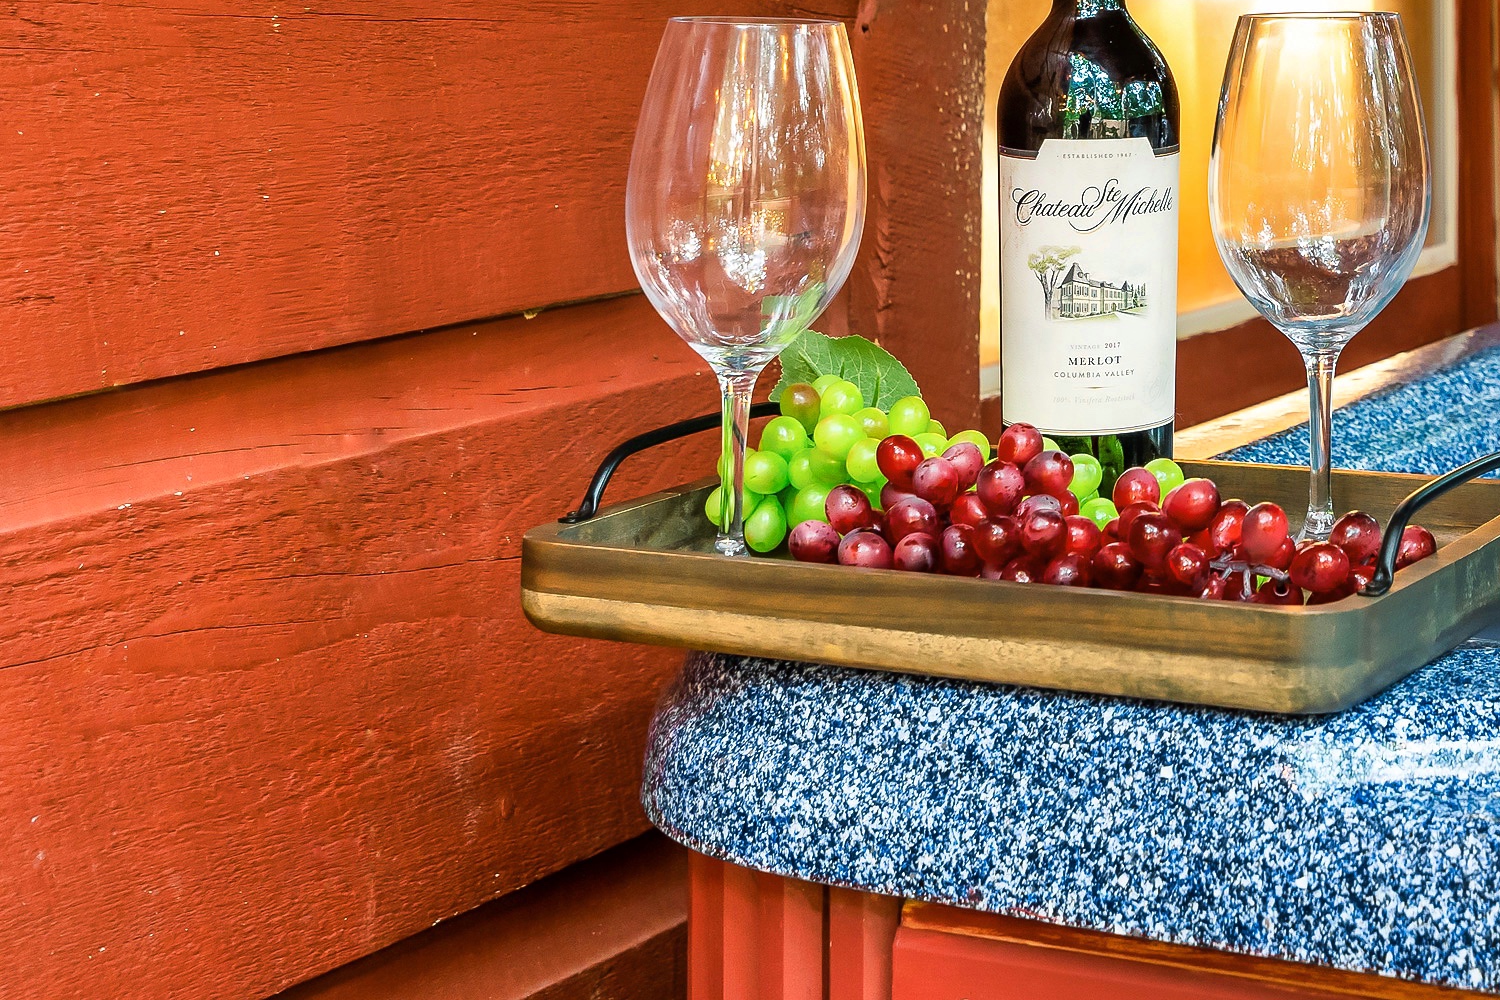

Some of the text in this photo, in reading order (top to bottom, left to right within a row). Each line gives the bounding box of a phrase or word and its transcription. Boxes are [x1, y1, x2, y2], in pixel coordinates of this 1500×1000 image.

[1012, 178, 1173, 229] Chateau Ste Michelle
[1104, 341, 1121, 349] 2017
[1068, 355, 1122, 366] MERLOT
[1053, 369, 1135, 379] COLUMBIA VALLEY
